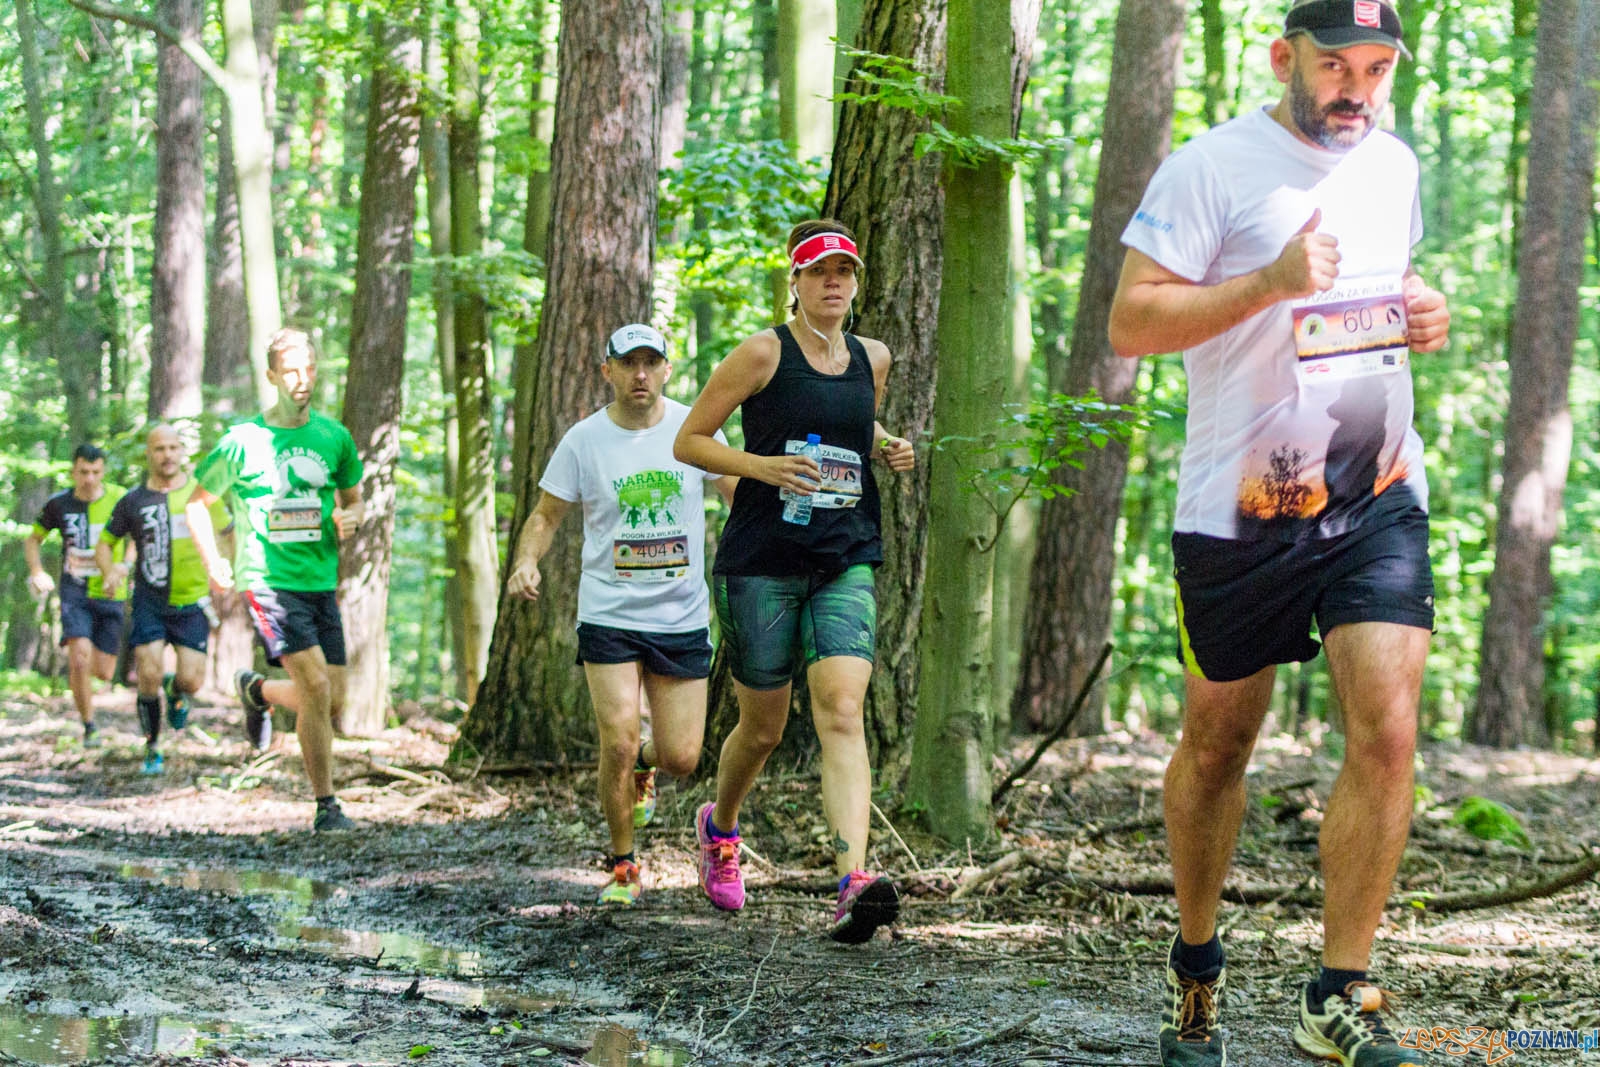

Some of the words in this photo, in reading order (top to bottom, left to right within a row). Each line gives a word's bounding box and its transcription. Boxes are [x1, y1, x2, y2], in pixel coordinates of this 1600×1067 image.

[1343, 306, 1373, 333] 60
[822, 449, 831, 457] ZA
[832, 451, 857, 461] WILKIEM
[613, 470, 685, 491] MARATON
[656, 529, 682, 537] WILKIEM
[637, 543, 668, 558] 404
